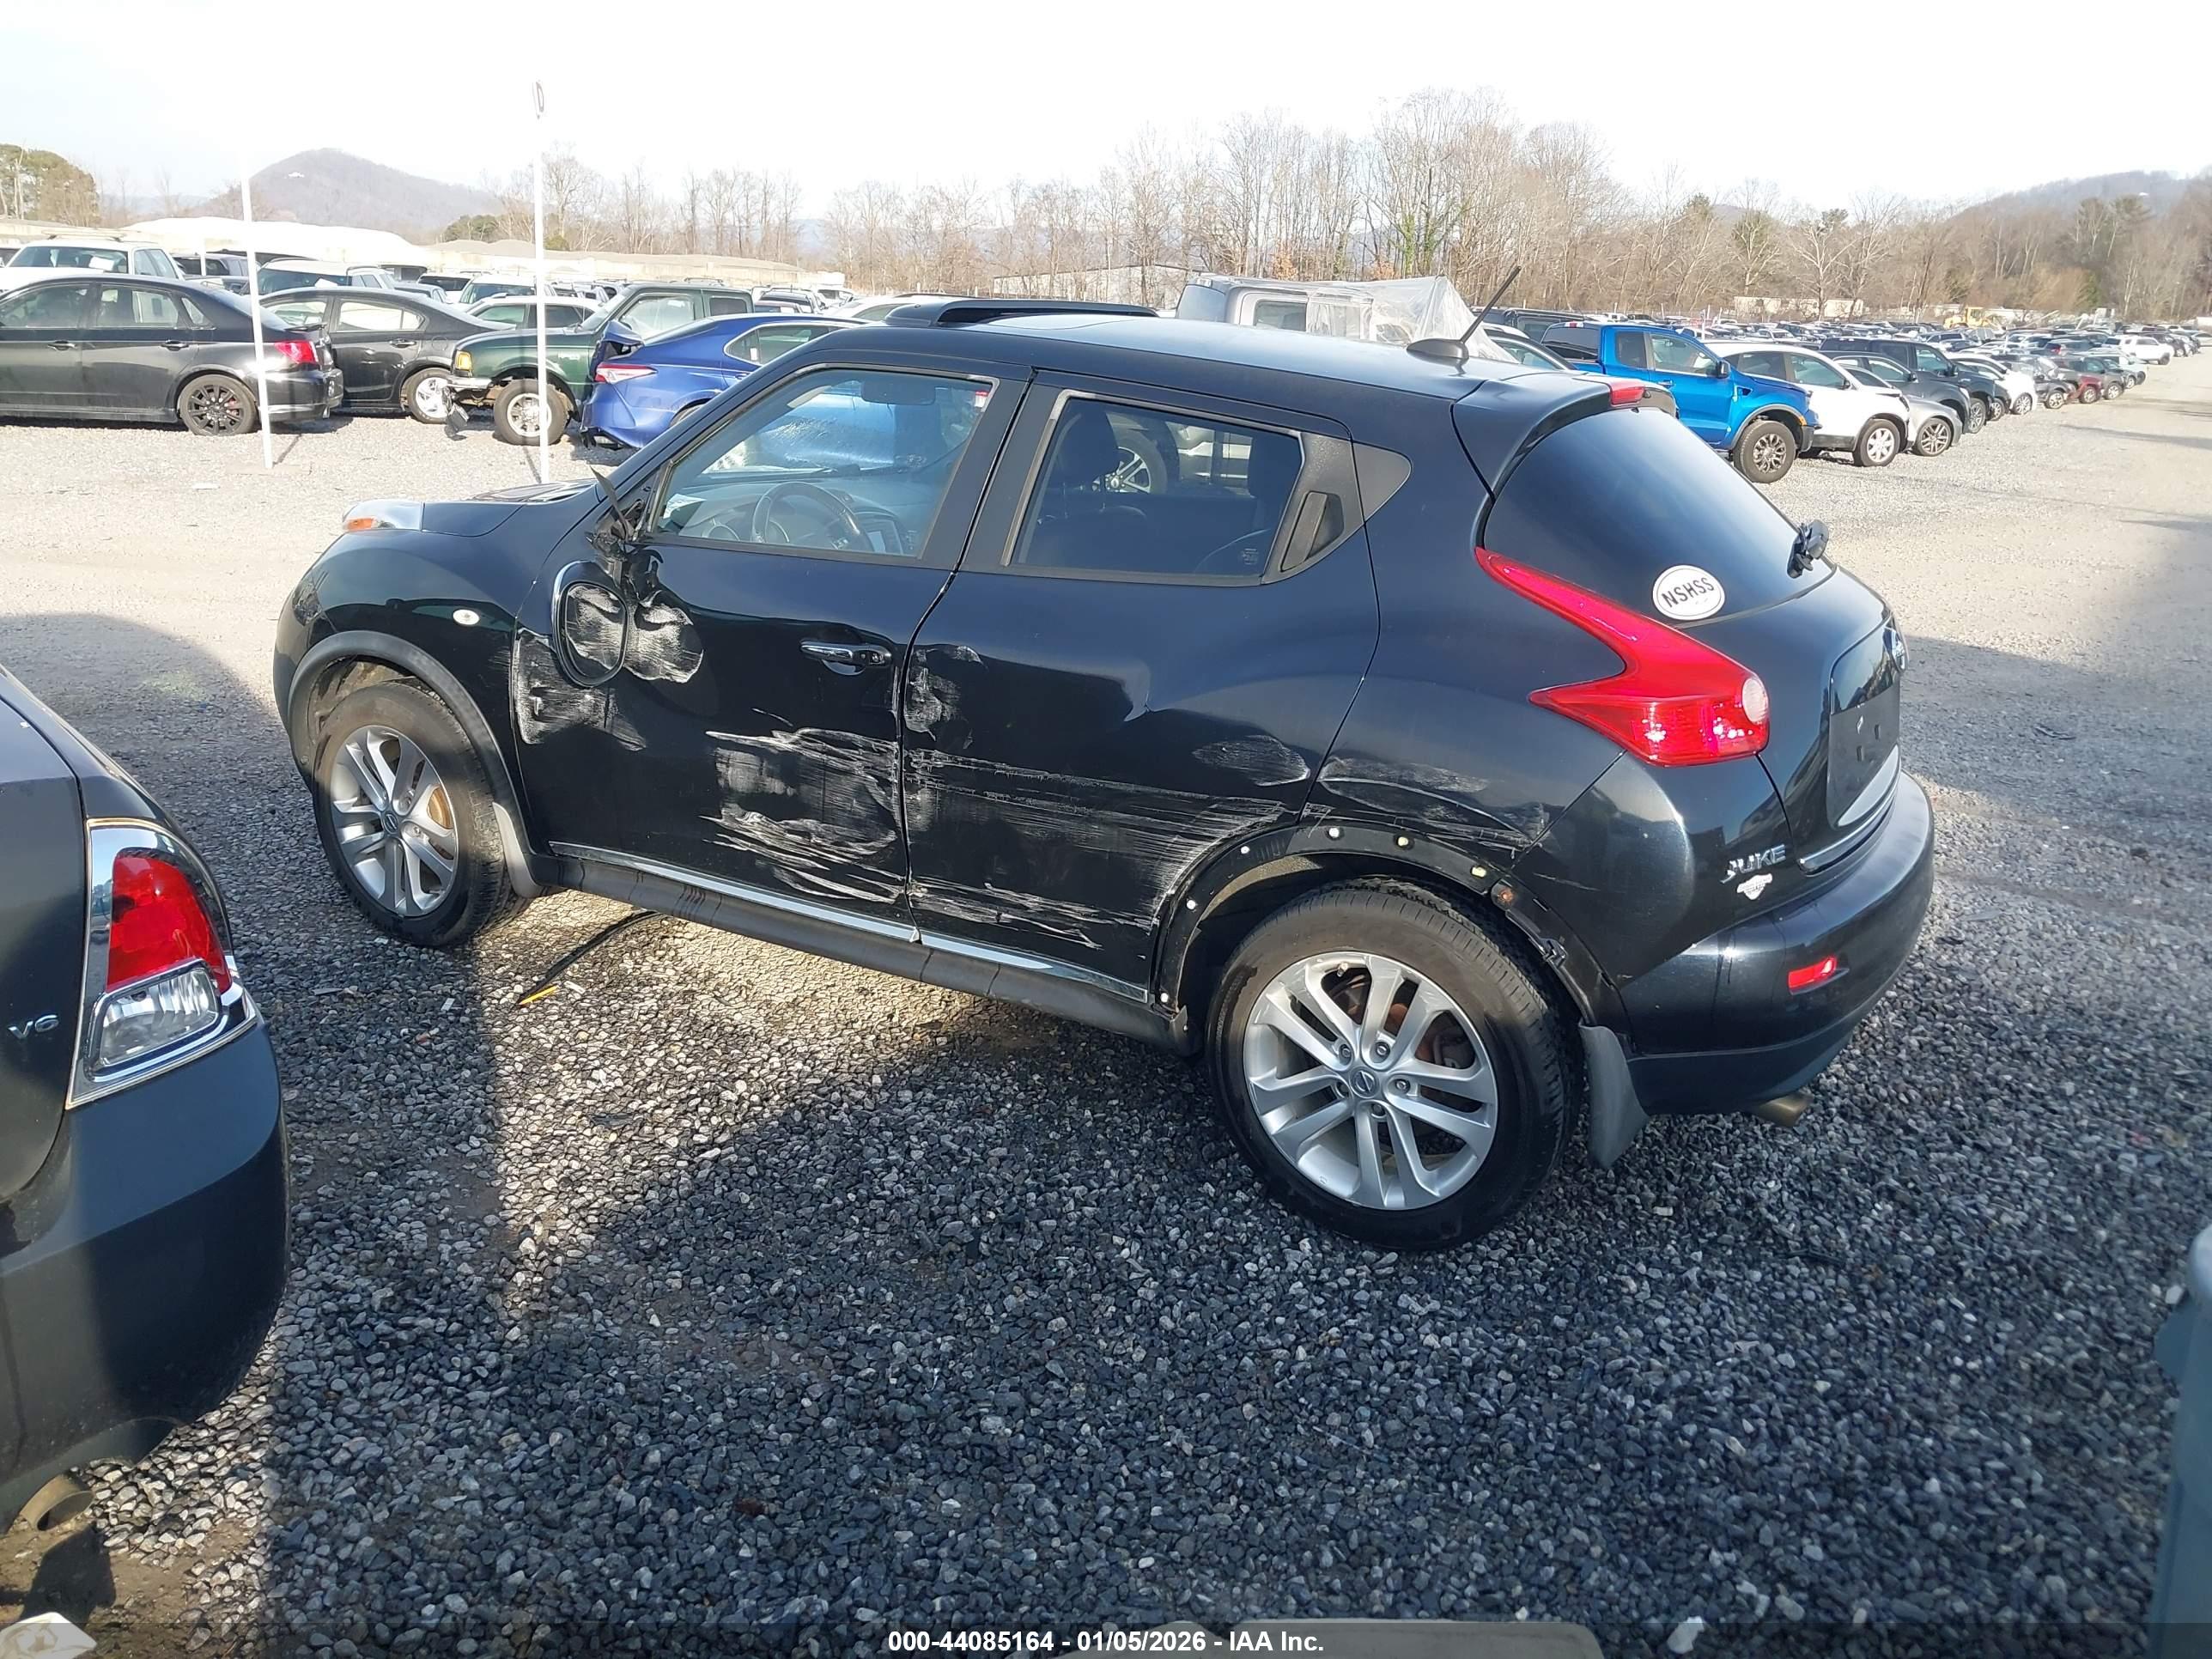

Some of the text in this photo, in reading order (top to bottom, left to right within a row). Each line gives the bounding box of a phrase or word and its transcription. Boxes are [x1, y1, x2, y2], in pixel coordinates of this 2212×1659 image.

[1661, 577, 1715, 608] NSHSS
[1720, 844, 1787, 884] JUKE
[8, 1014, 59, 1039] V6
